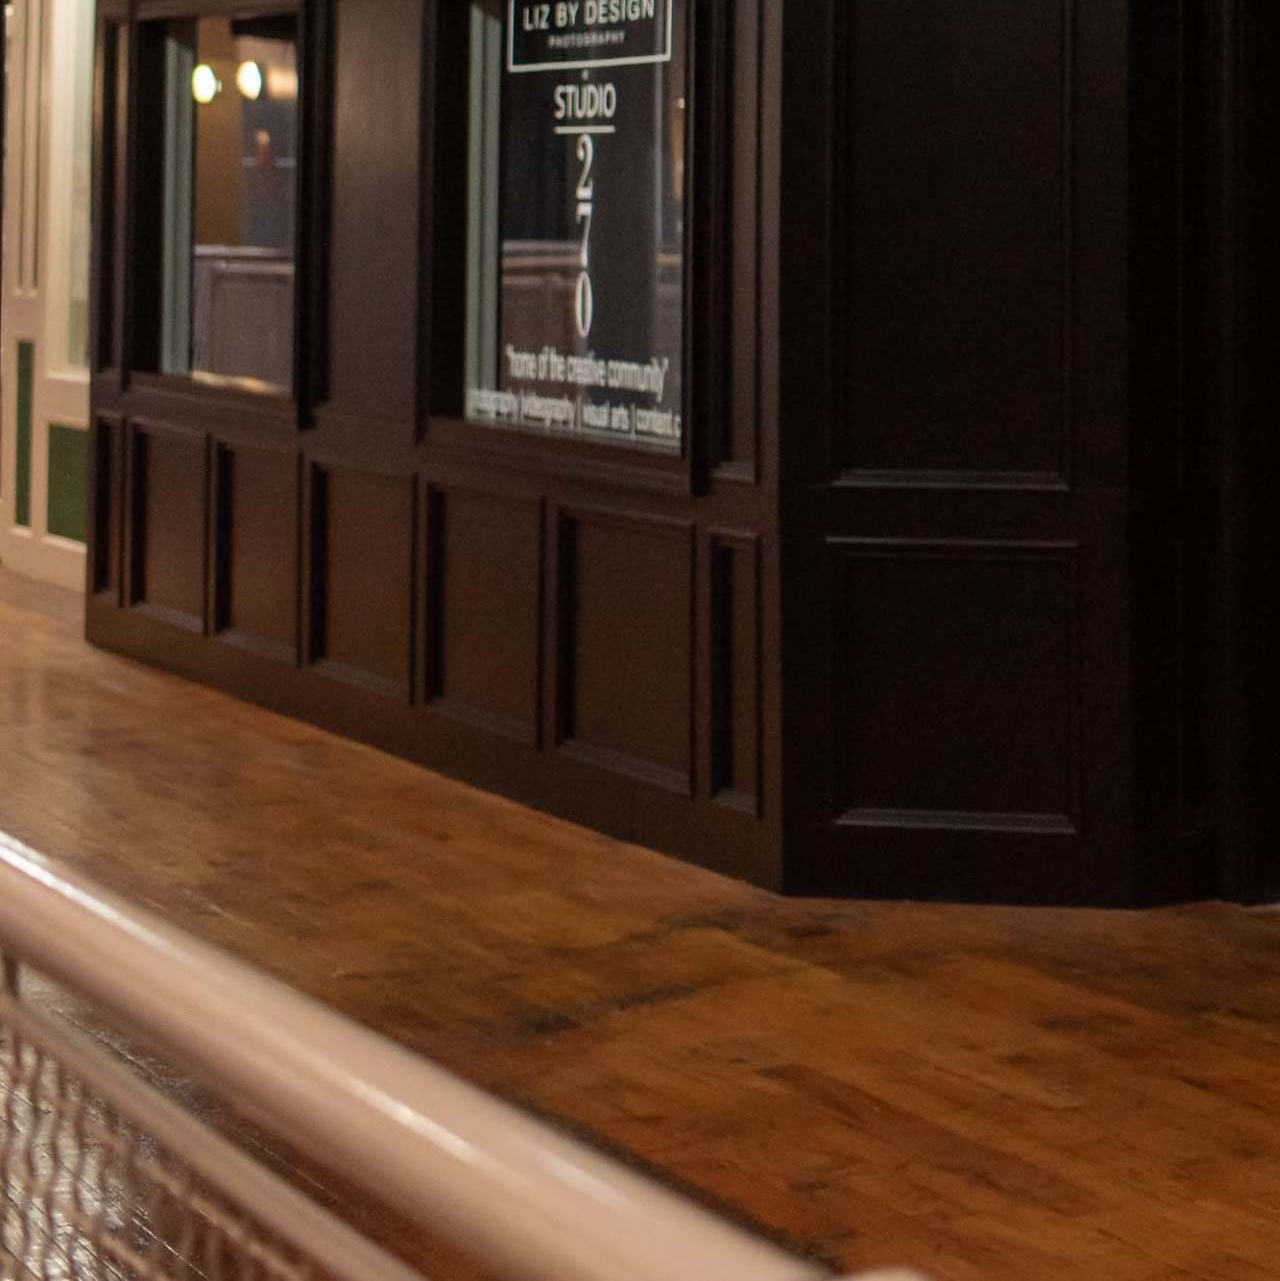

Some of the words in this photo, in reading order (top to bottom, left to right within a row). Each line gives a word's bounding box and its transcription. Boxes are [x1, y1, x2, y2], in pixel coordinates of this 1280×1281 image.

[522, 4, 550, 31] LIZ
[555, 0, 580, 28] BY
[554, 82, 617, 119] STUDIO
